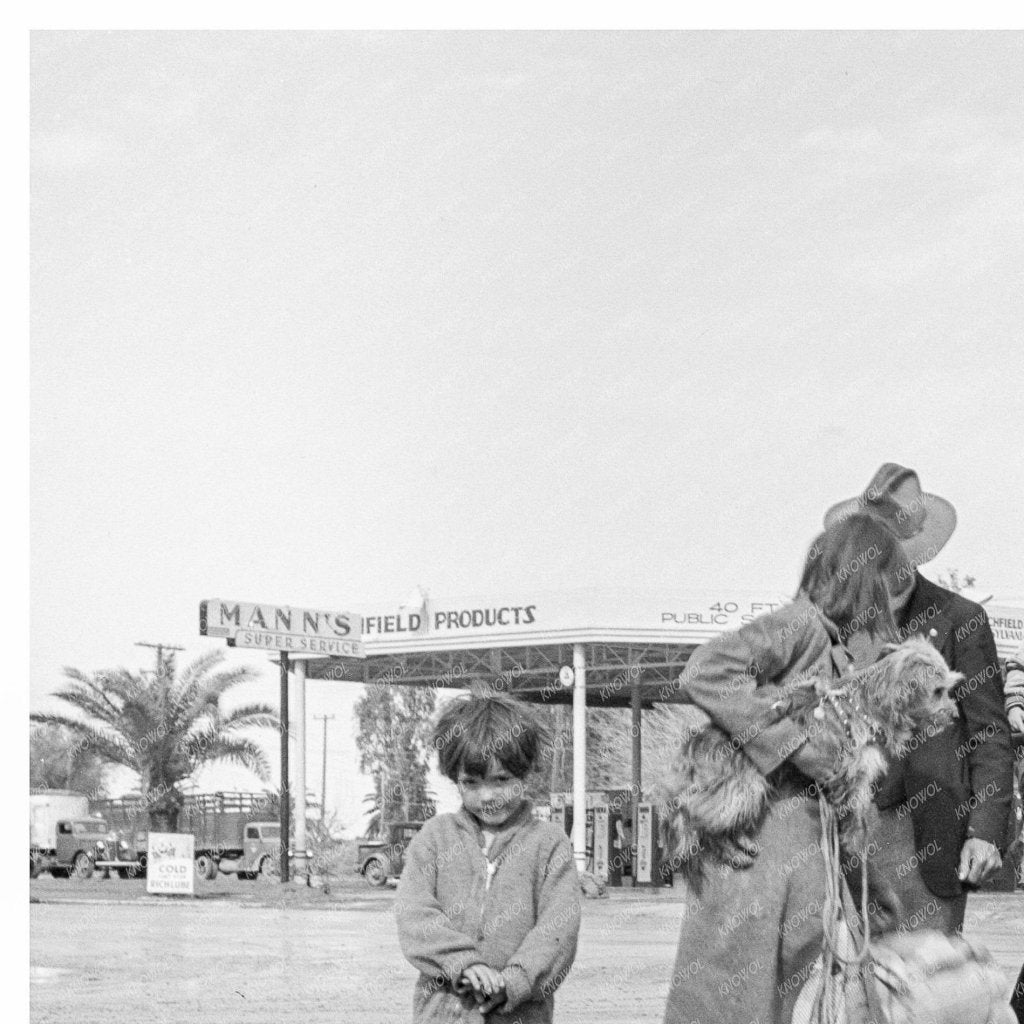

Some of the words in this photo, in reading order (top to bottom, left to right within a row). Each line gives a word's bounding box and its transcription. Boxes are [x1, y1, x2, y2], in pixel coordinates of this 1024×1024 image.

[709, 602, 738, 613] 40
[220, 603, 352, 636] MANN'S
[361, 614, 421, 635] FIELD
[434, 605, 537, 630] PRODUCTS
[661, 612, 728, 624] PUBLIC
[244, 632, 293, 648] SUPER
[300, 639, 359, 654] SERVICE
[159, 865, 187, 874] COLD
